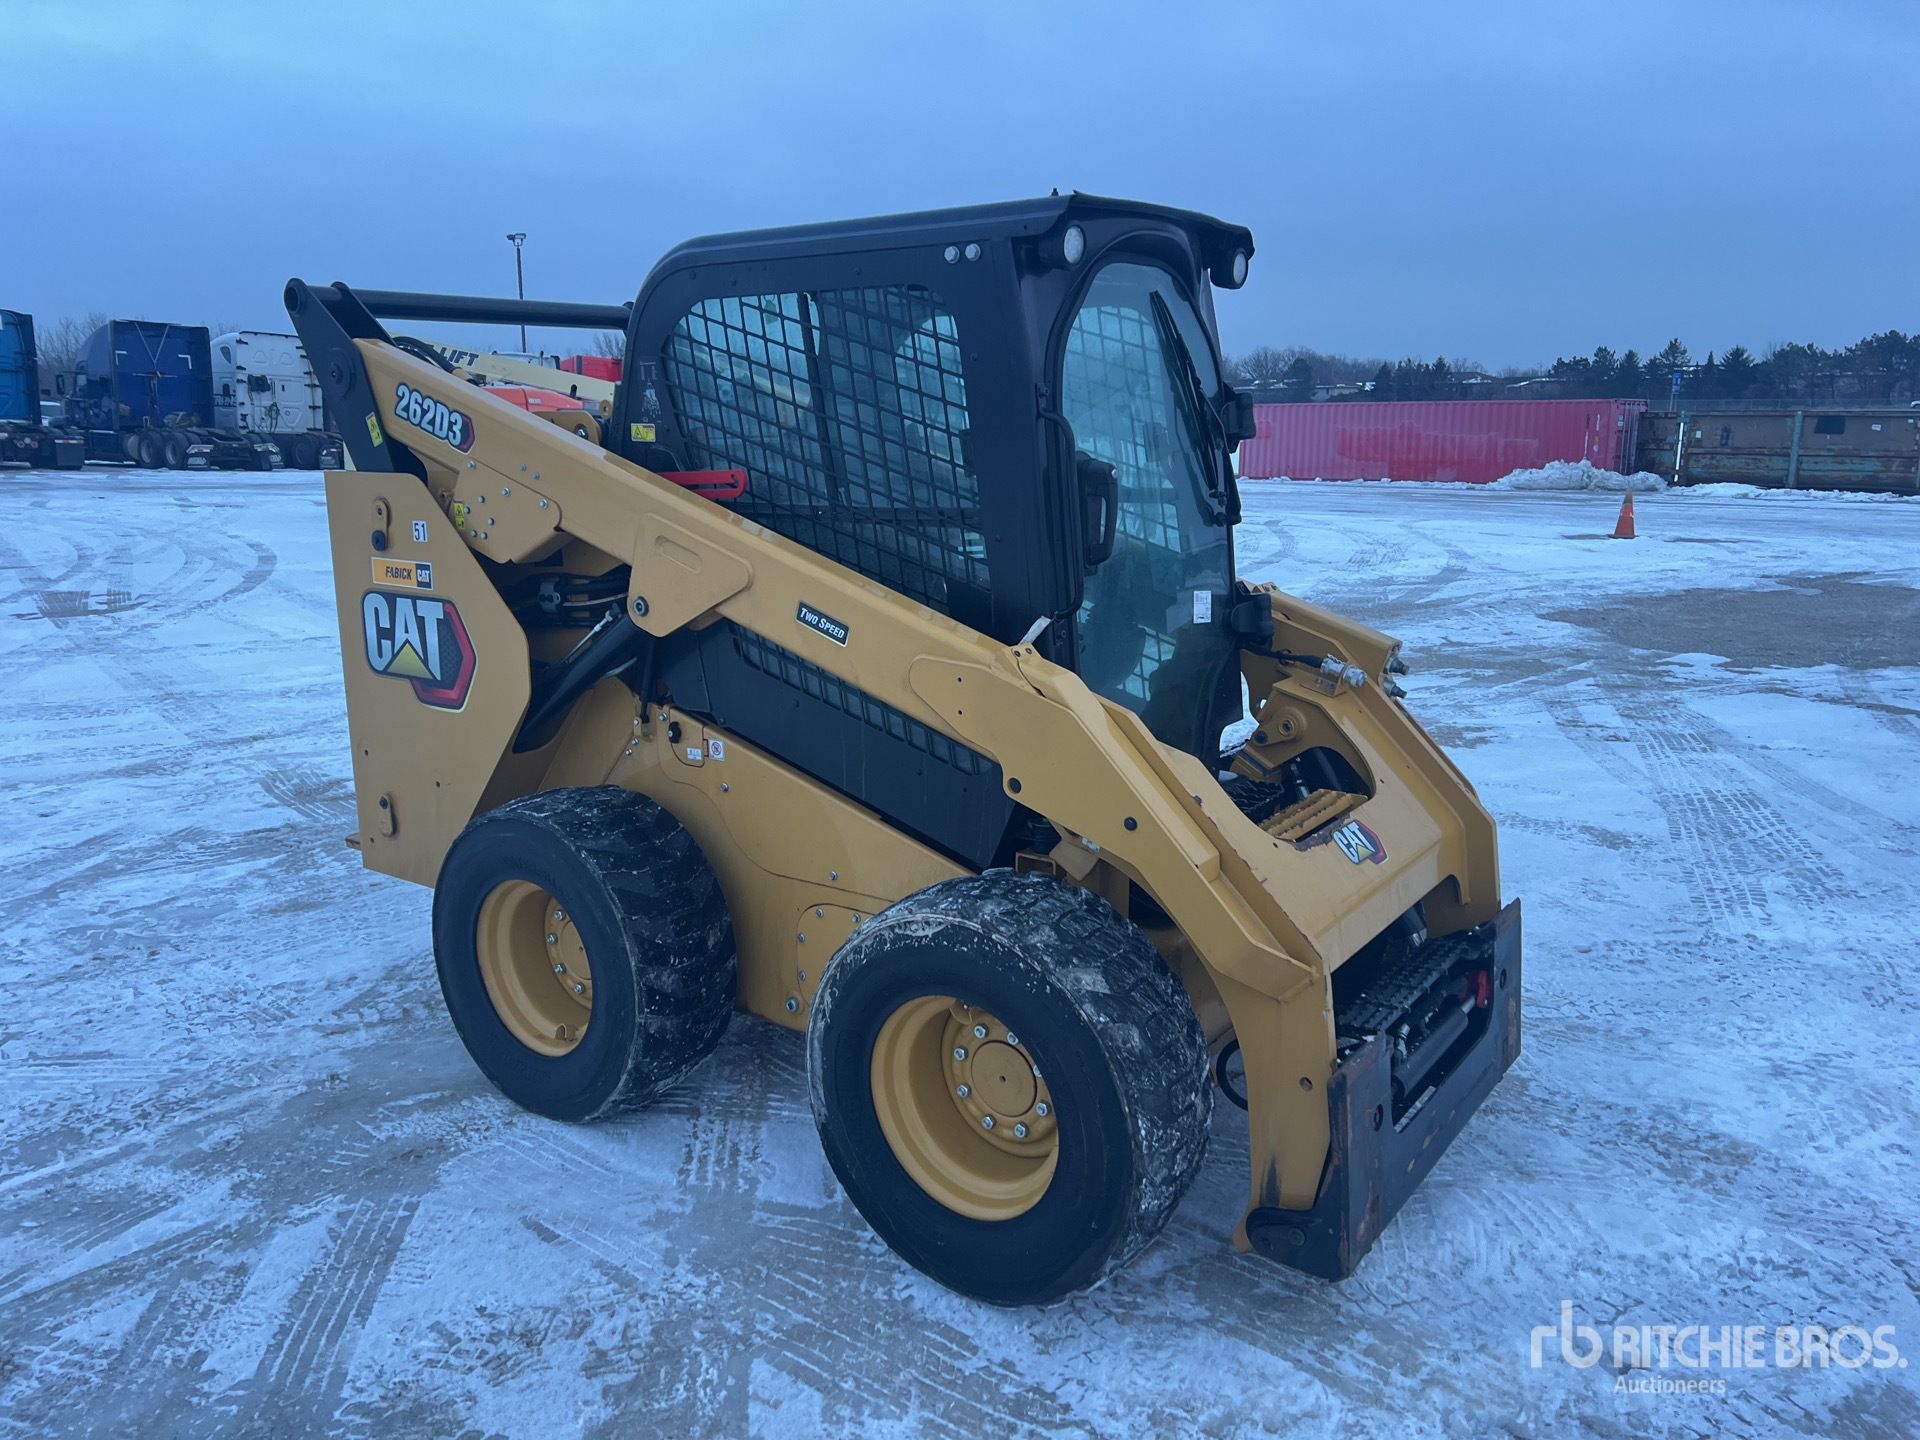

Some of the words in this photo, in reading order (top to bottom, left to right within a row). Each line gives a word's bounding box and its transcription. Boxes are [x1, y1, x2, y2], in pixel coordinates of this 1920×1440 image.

[395, 384, 463, 446] 262D3
[413, 522, 426, 541] 51
[385, 566, 412, 580] FABICK
[417, 569, 430, 583] CAT
[363, 593, 444, 681] CAT
[1333, 822, 1375, 863] CAT
